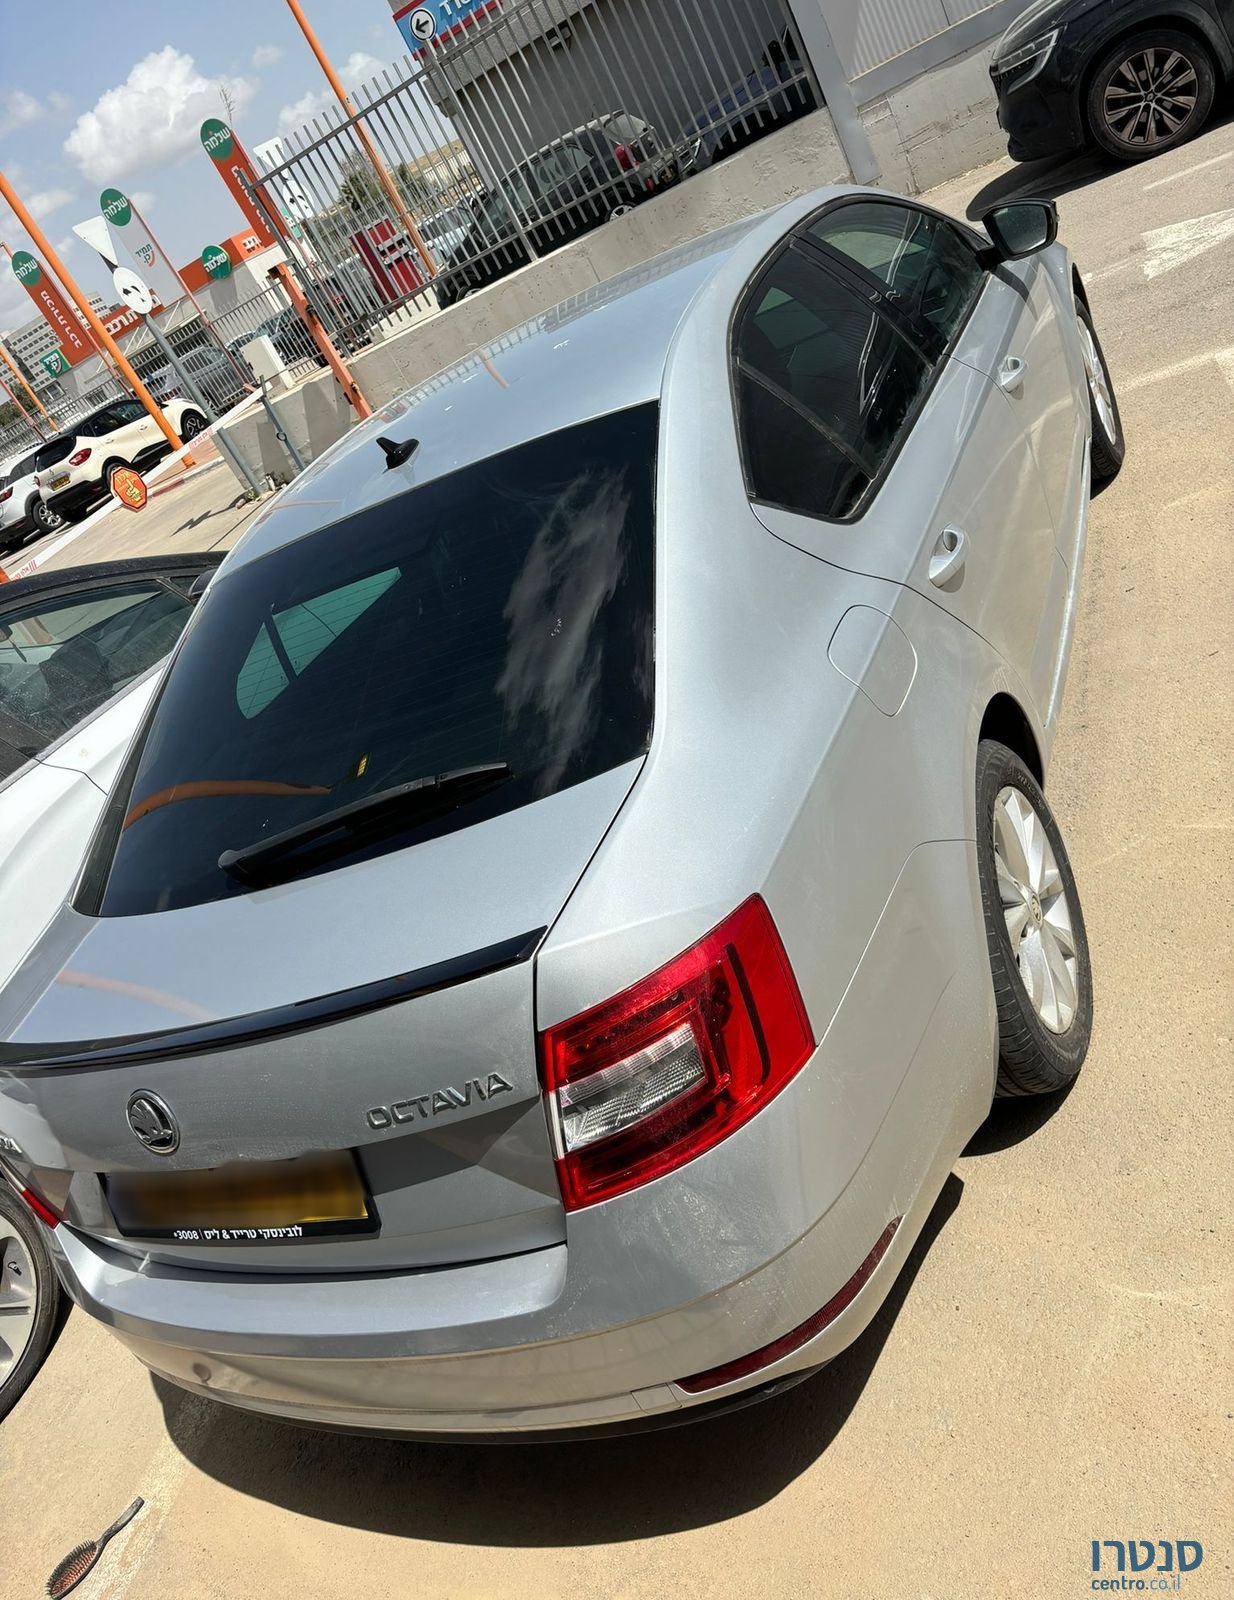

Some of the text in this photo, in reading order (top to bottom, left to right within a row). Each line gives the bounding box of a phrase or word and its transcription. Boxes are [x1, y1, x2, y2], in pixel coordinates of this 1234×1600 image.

[204, 127, 231, 152] שלמה
[103, 196, 128, 219] שלמה
[135, 243, 153, 259] תמיד
[15, 258, 38, 279] שלמה
[203, 251, 228, 273] שלמה
[40, 290, 83, 349] מכירת רכב
[366, 1071, 514, 1130] OCTAVIA
[203, 1228, 220, 1240] ליס
[221, 1230, 230, 1240] &
[230, 1229, 257, 1239] טרייד
[258, 1225, 303, 1240] לובינסקי
